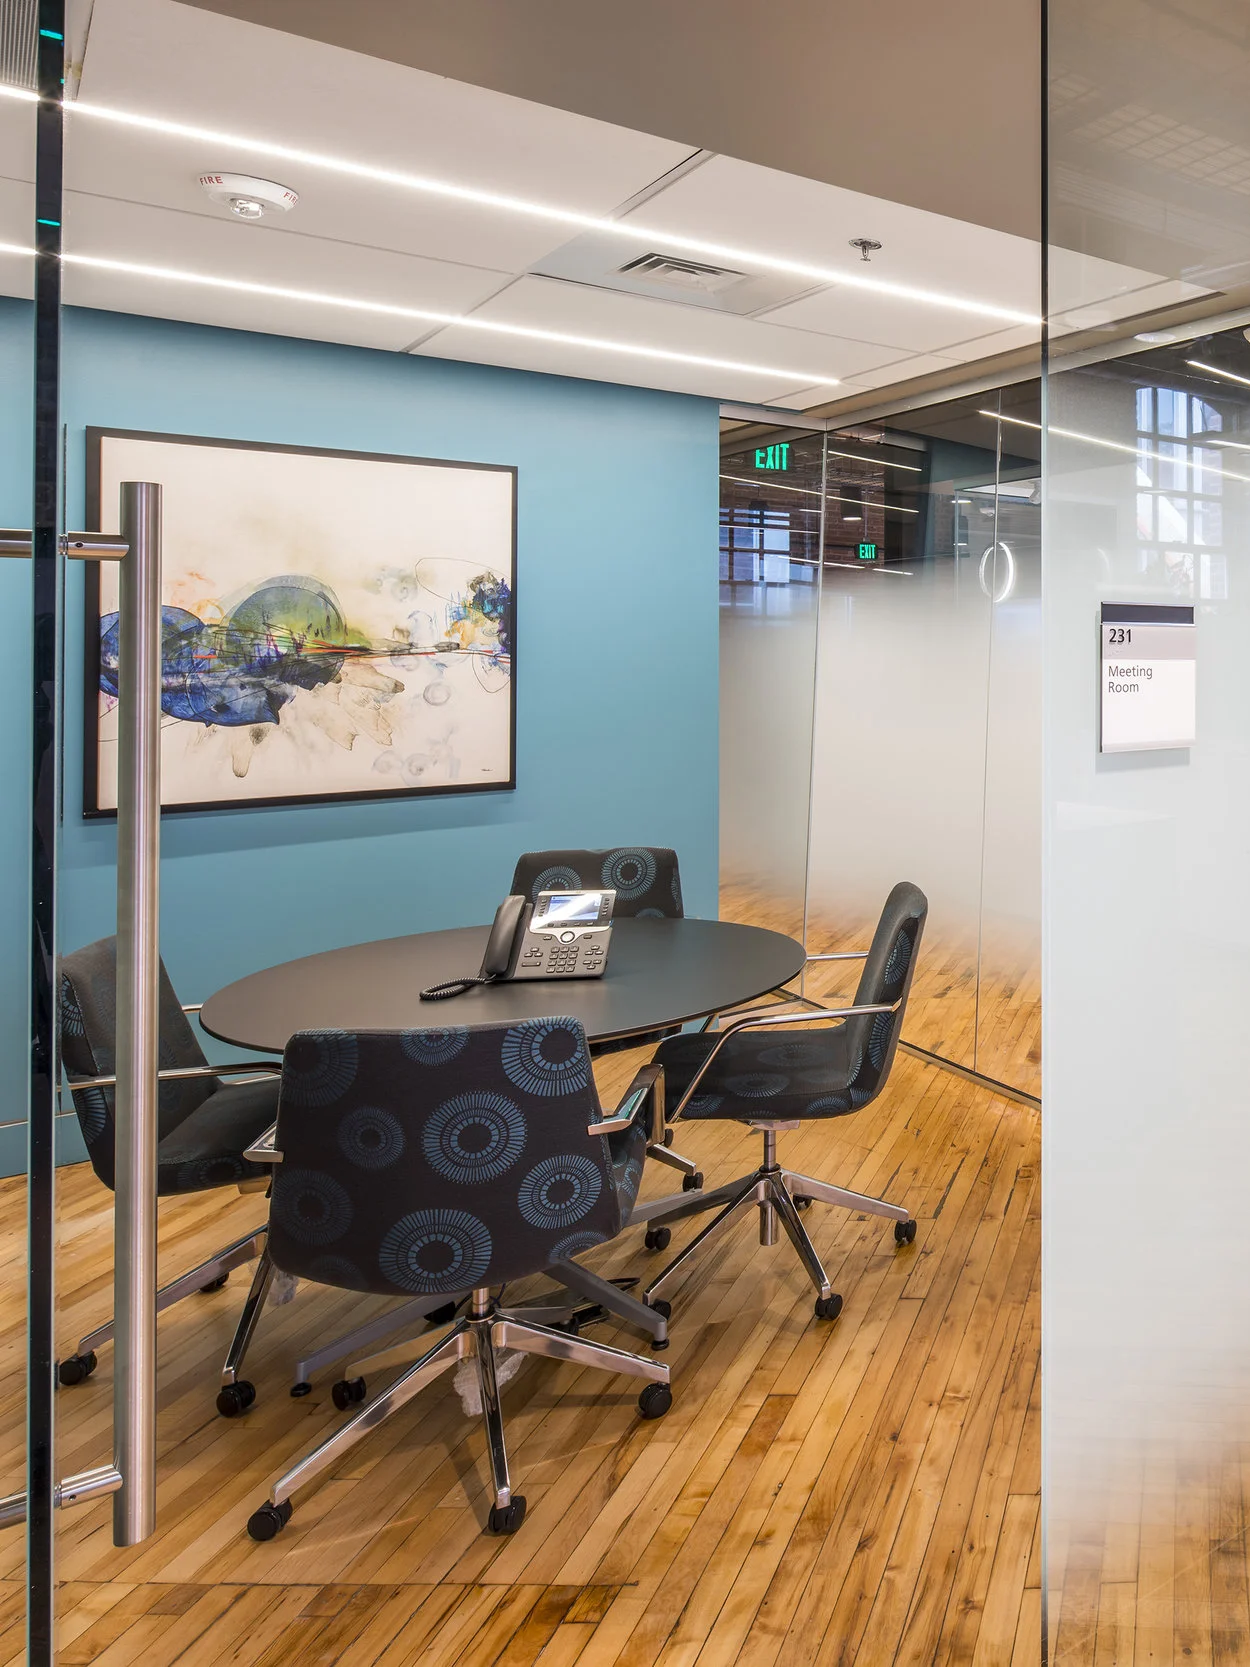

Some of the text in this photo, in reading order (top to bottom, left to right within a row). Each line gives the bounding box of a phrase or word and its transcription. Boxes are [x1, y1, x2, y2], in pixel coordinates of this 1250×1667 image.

[200, 176, 223, 186] FIRE
[284, 192, 298, 205] FIR
[755, 443, 790, 471] EXIT
[859, 544, 876, 559] EXIT
[1108, 628, 1132, 643] 231
[1108, 665, 1153, 680] Meeting
[1108, 681, 1139, 693] Room
